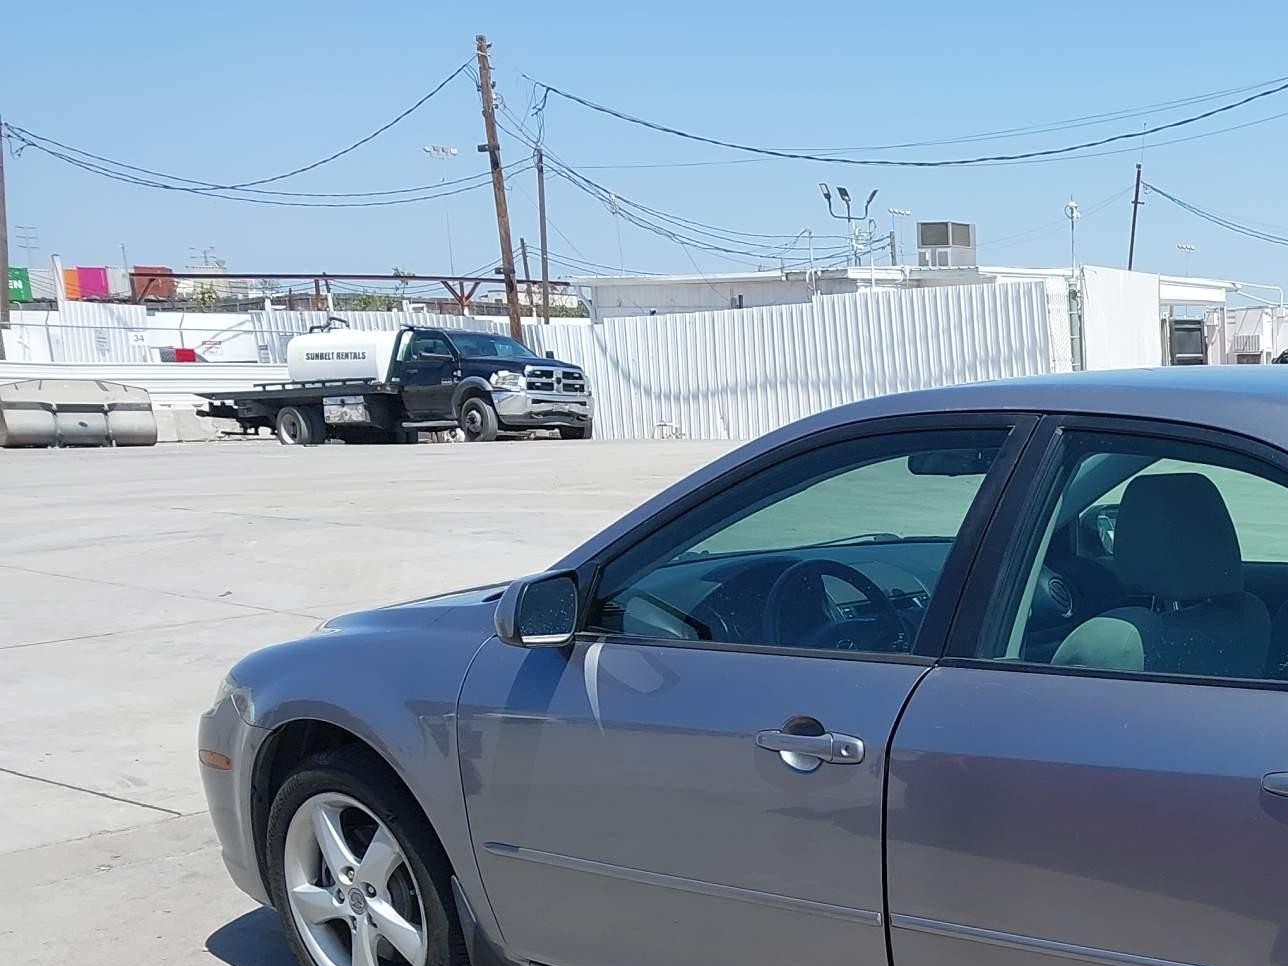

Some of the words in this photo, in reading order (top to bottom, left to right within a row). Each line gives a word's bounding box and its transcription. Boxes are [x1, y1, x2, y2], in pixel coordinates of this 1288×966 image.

[133, 334, 145, 342] 34
[305, 351, 335, 361] SUNBELT
[336, 351, 367, 361] RENTALS
